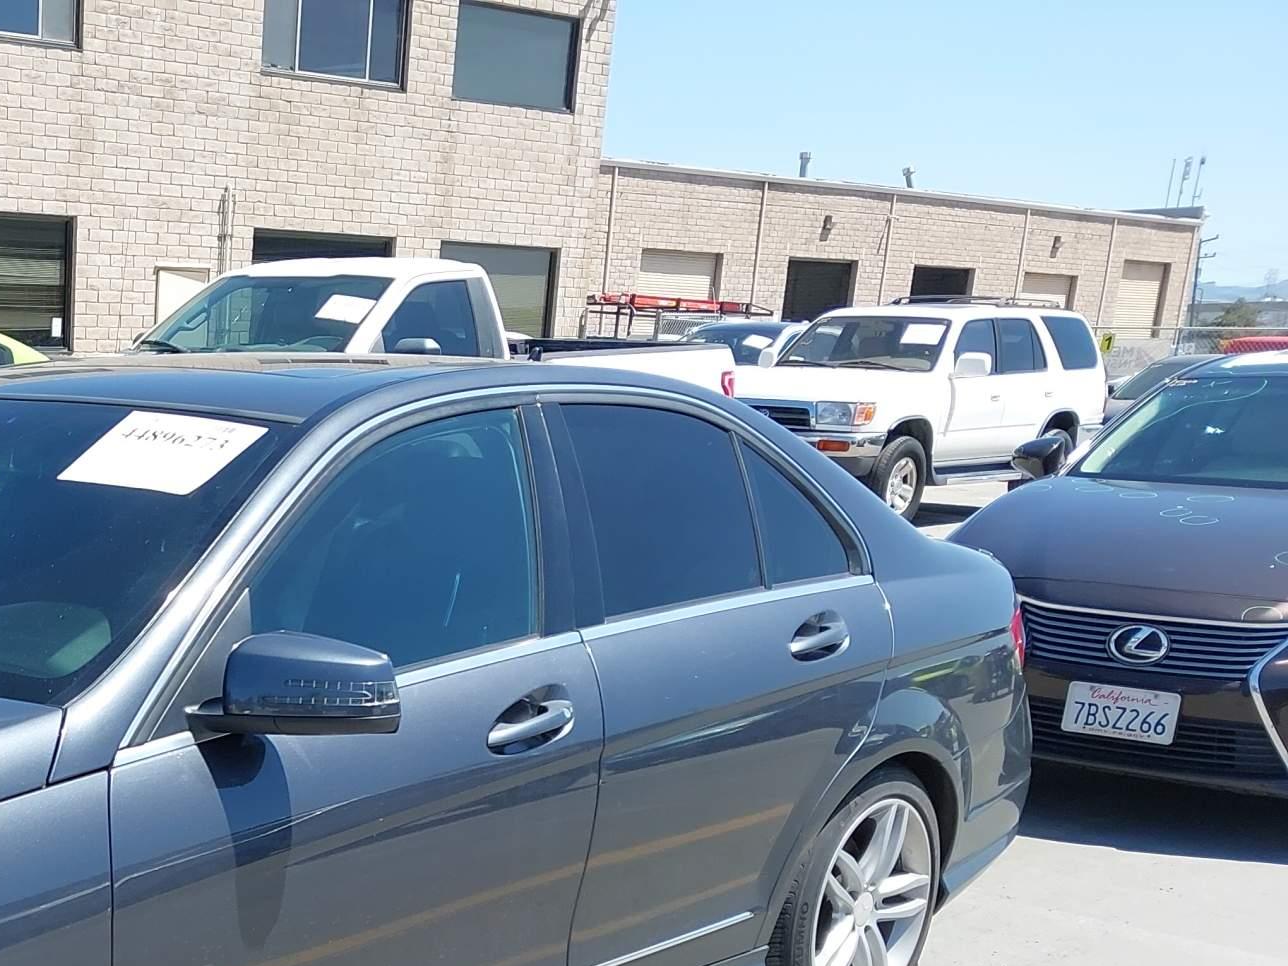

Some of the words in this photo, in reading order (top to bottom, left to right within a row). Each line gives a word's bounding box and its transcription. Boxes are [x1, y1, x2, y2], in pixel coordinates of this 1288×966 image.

[1105, 336, 1113, 351] 1
[1091, 688, 1159, 706] California
[1073, 701, 1170, 736] 7BSZ266
